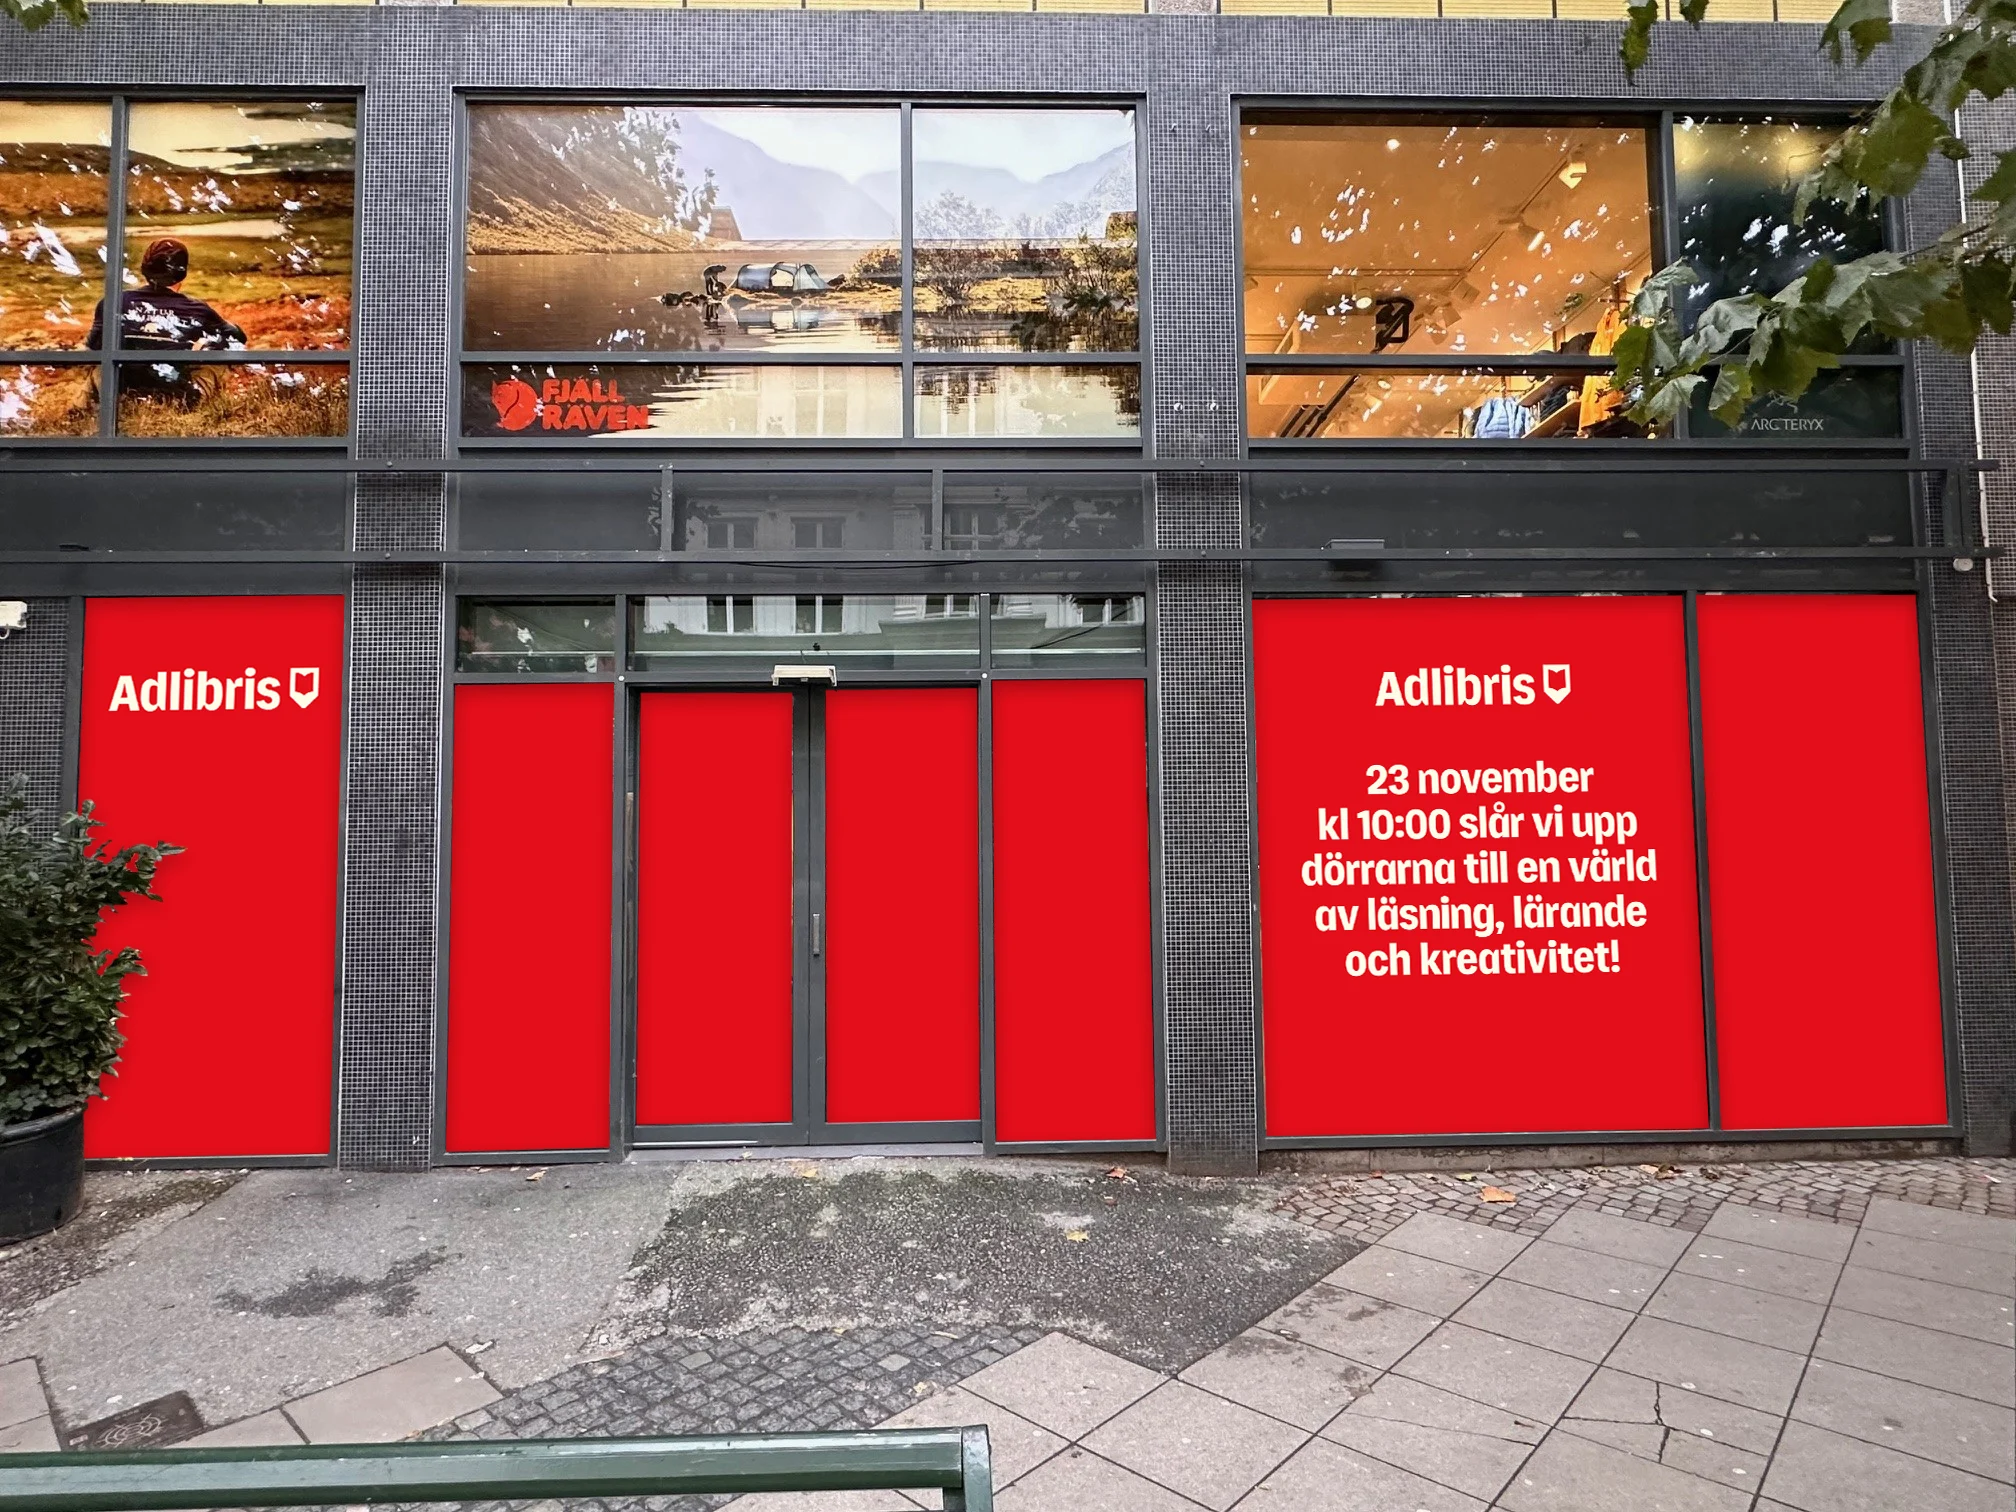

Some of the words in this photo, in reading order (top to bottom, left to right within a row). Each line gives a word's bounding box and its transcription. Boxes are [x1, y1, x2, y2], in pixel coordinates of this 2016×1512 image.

[109, 667, 281, 712] Adlibris
[1375, 664, 1536, 707] Adlibris
[1366, 765, 1410, 796] 23
[1418, 761, 1595, 795] november
[1318, 808, 1349, 841] kl
[1357, 809, 1451, 842] 10:00
[1459, 801, 1525, 840] slår
[1532, 804, 1564, 839] vi
[1571, 812, 1638, 845] upp
[1301, 852, 1456, 887] dörrarna
[1463, 849, 1509, 884] till
[1517, 857, 1561, 884] en
[1567, 849, 1657, 884] värld
[1315, 905, 1360, 932] av
[1367, 896, 1505, 938] läsning,
[1513, 894, 1647, 930] lärande
[1345, 943, 1411, 977] och
[1419, 939, 1621, 976] kreativitet!
